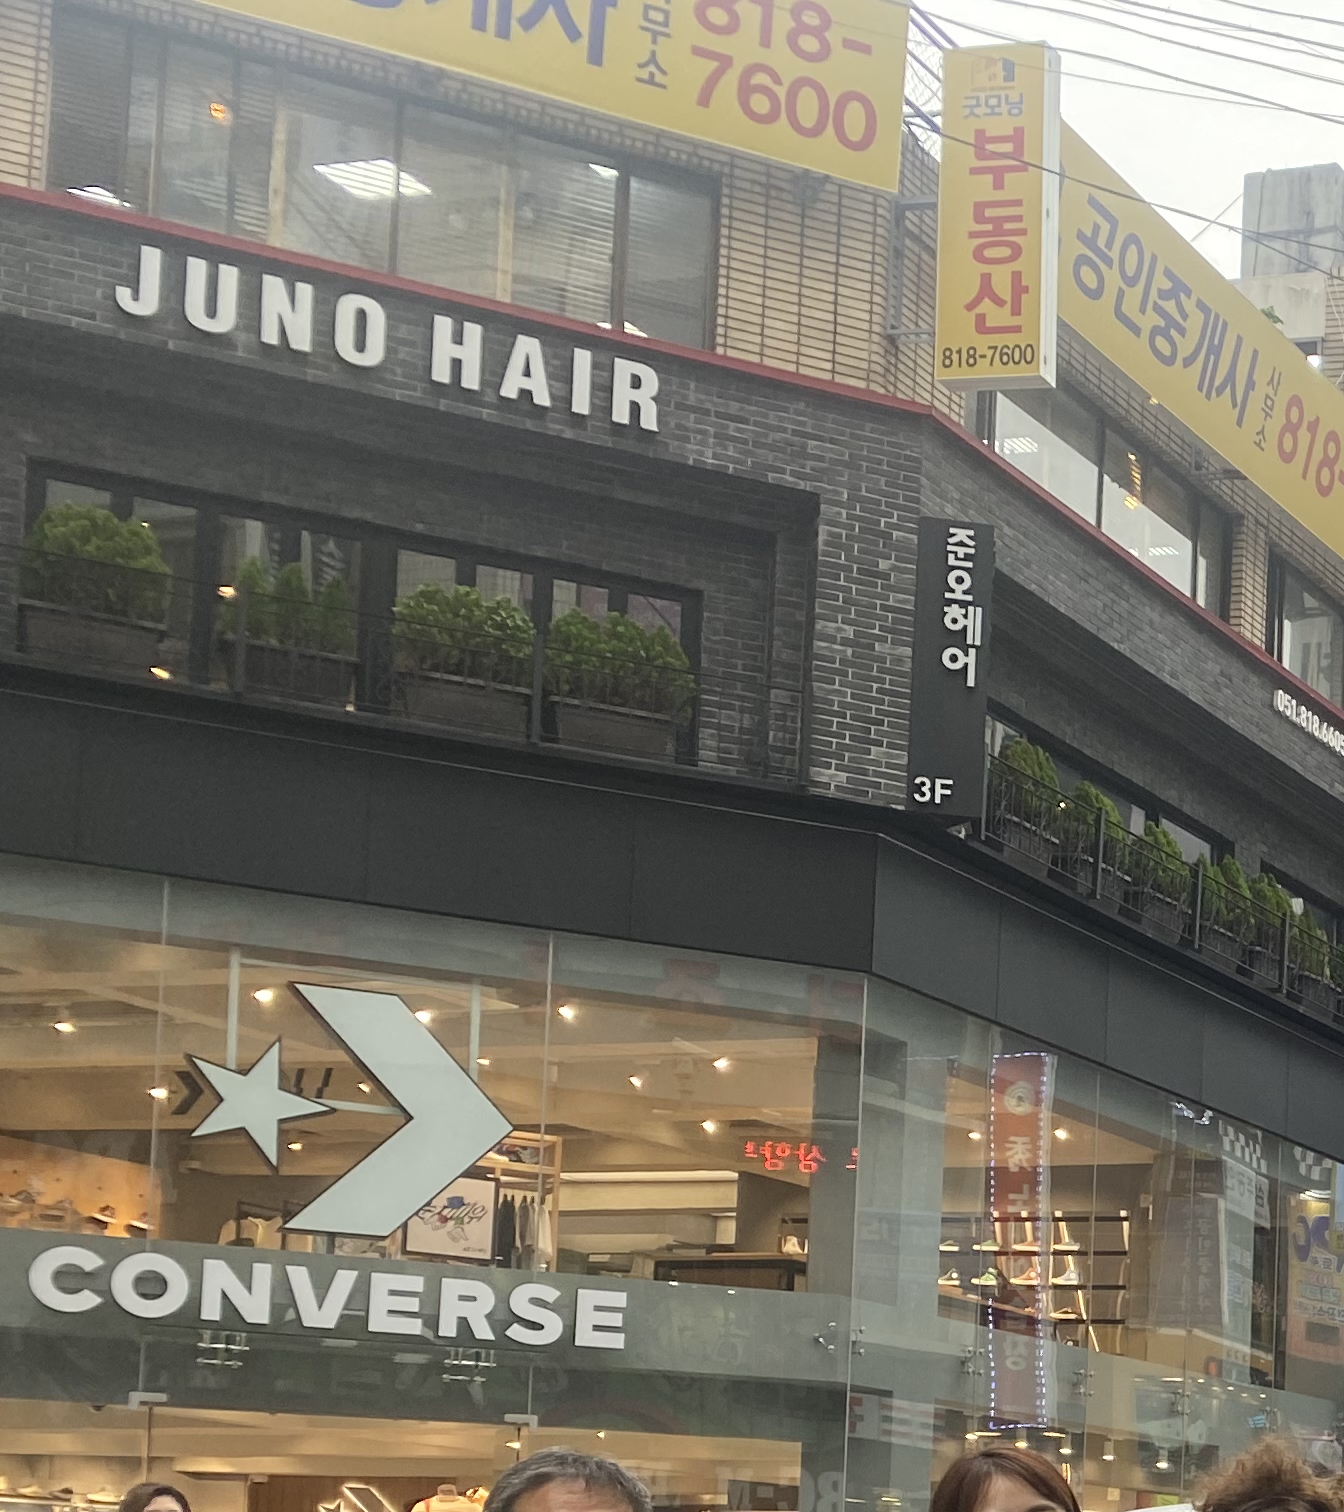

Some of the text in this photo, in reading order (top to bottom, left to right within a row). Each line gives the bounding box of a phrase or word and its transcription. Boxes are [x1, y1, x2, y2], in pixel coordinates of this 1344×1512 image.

[690, 45, 877, 152] 7600
[961, 91, 1024, 119] 굿모닝
[963, 126, 1030, 335] 부동산
[115, 245, 661, 433] JUNO HAIR
[941, 343, 1035, 369] 818-7600
[1072, 193, 1260, 429] 공인중개사
[1253, 366, 1282, 452] 사무소
[942, 527, 983, 689] 준오헤어
[914, 777, 953, 804] 3F
[27, 1245, 628, 1349] CONVERSE
